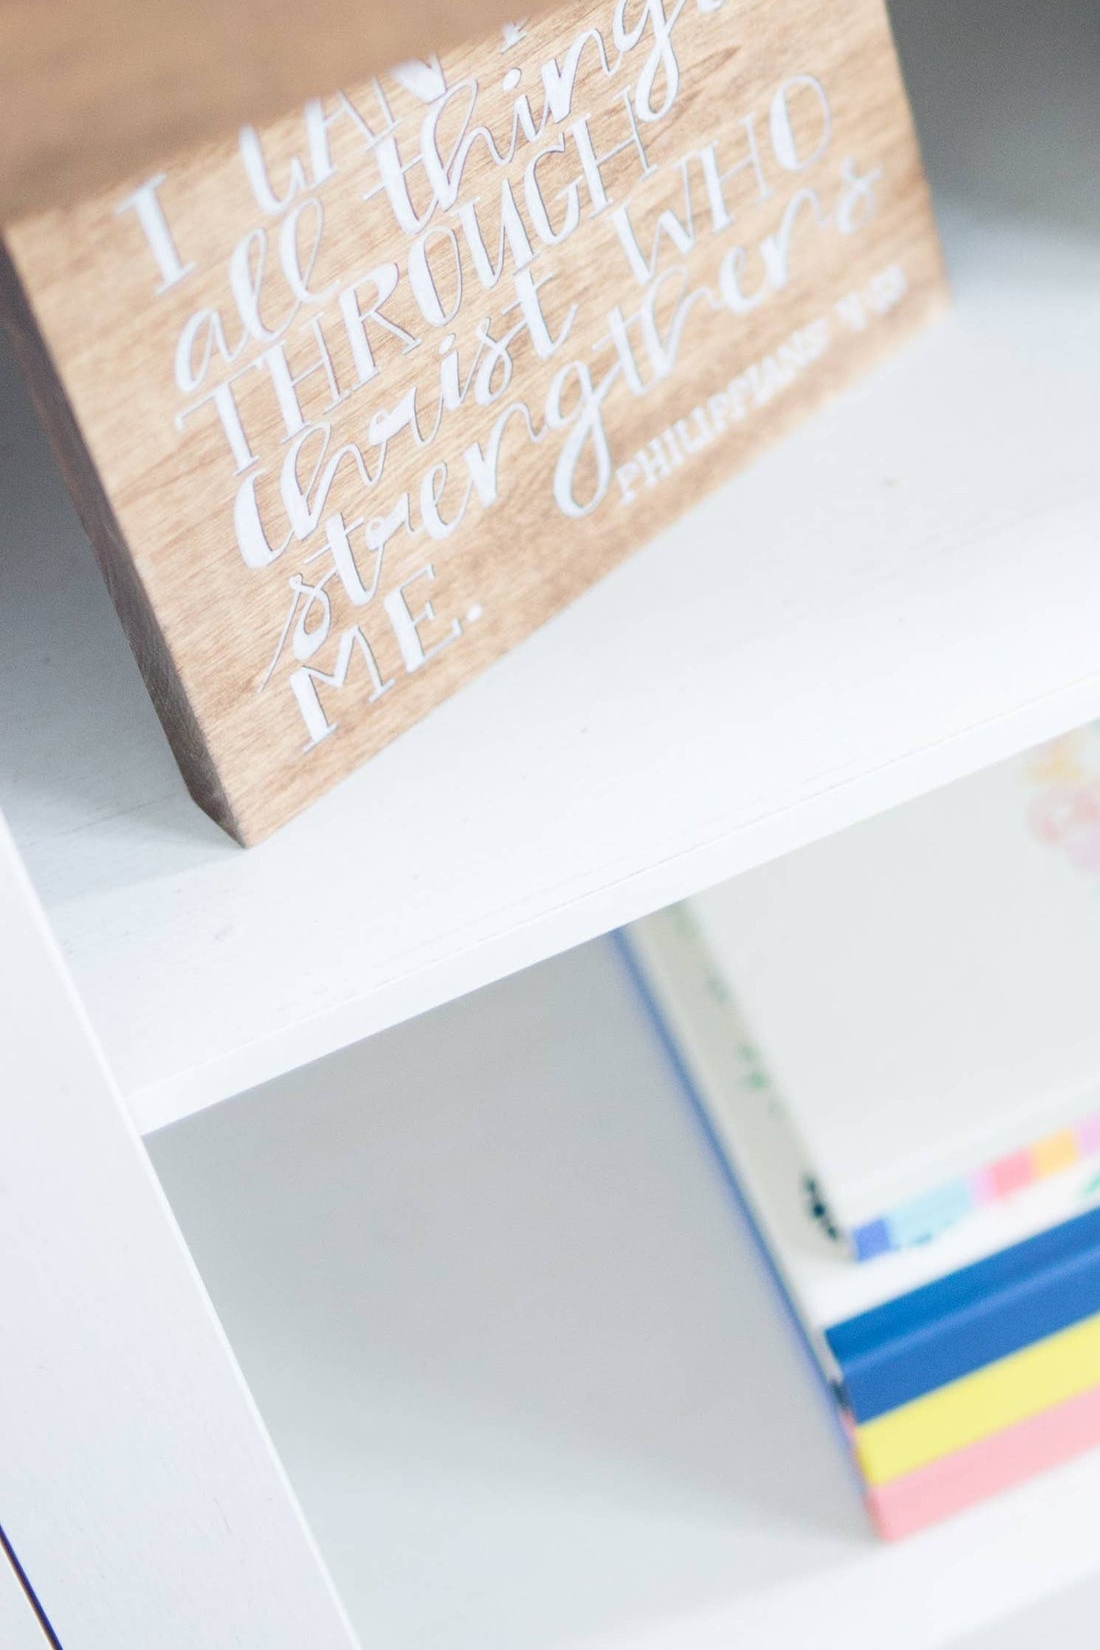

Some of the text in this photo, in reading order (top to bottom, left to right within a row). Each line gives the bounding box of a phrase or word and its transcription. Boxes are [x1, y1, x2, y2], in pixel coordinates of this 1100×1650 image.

[173, 83, 660, 478] THROUGH
[606, 72, 834, 288] WHO
[174, 196, 340, 393] all
[257, 156, 885, 694] strengthens
[614, 317, 830, 507] PHILIPPIANS
[289, 563, 484, 754] ME.
